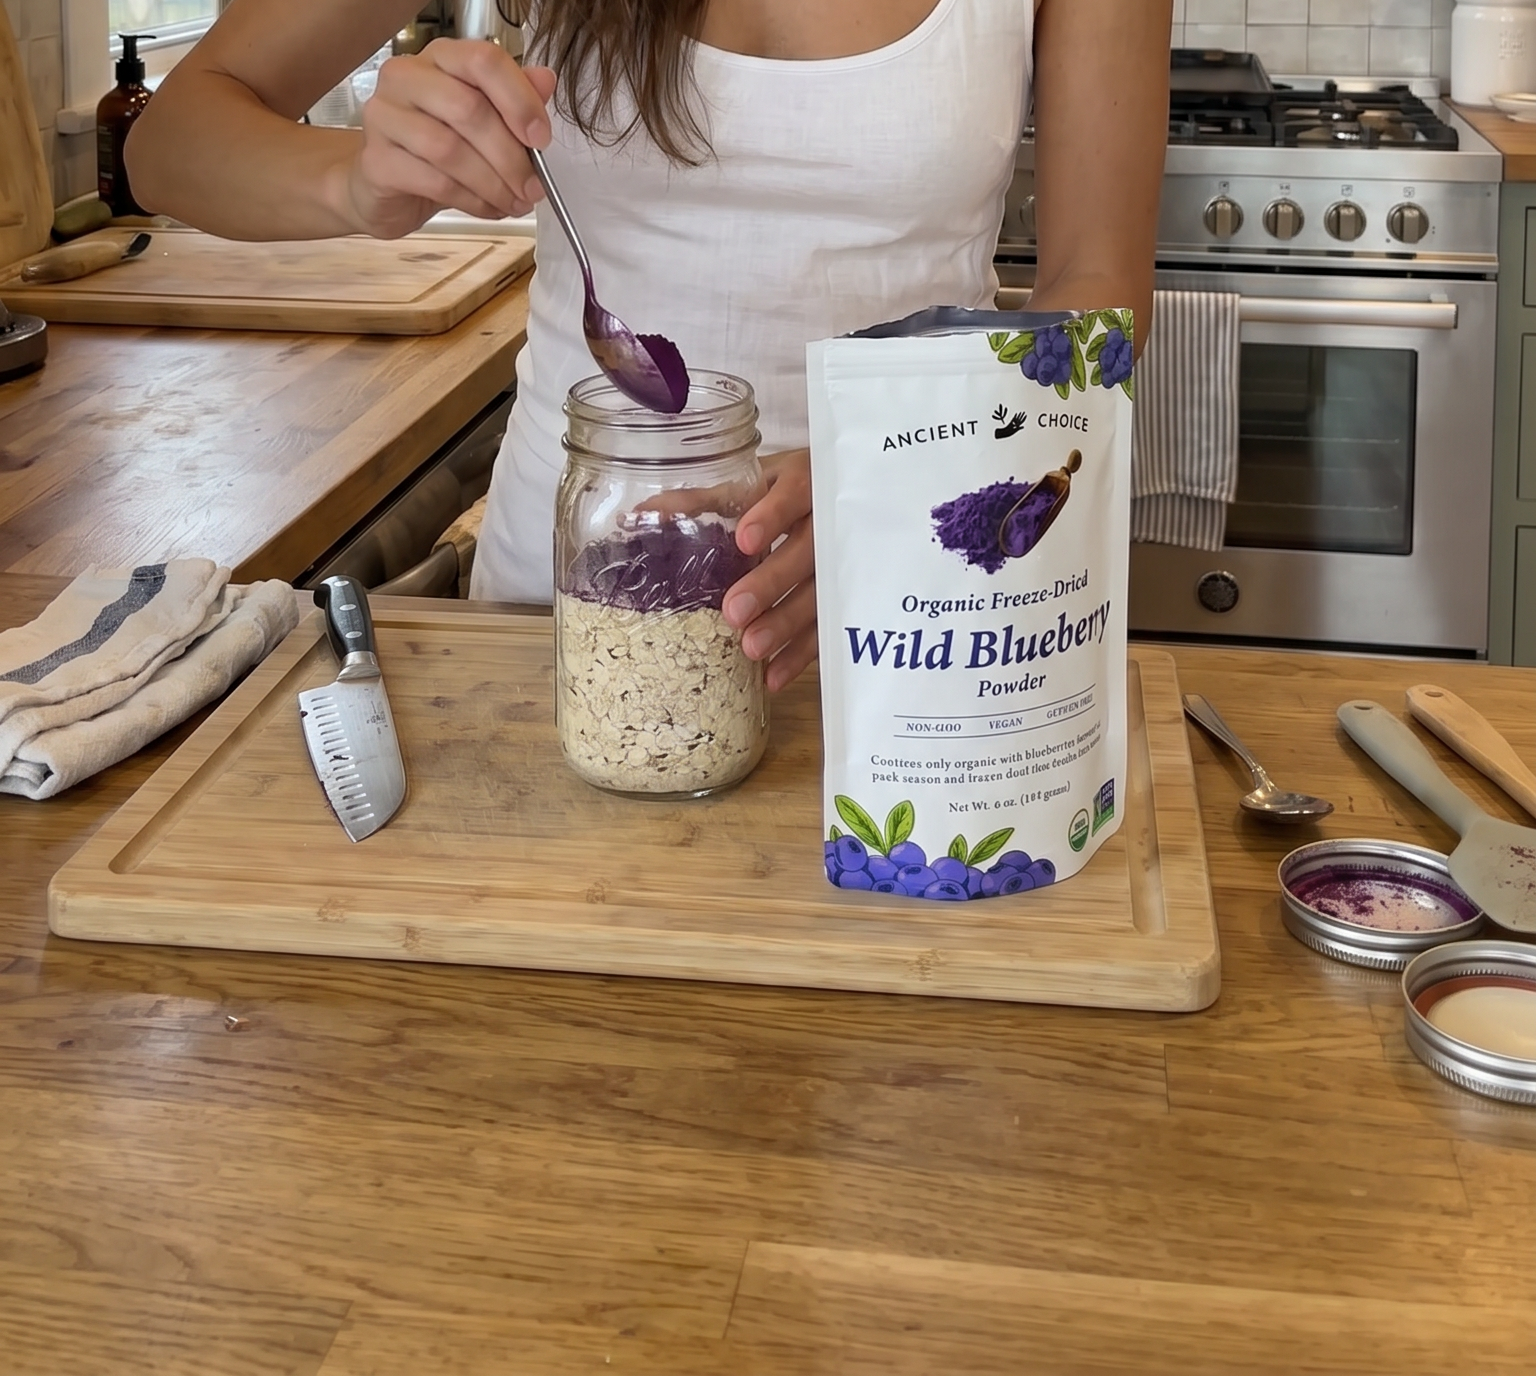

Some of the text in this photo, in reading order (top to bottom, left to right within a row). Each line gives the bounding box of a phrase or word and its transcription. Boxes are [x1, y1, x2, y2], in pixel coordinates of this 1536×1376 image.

[883, 412, 1089, 452] ANCIENT CHOICE
[901, 594, 985, 619] Organic
[844, 599, 1111, 671] Wild Blueberry
[976, 672, 1047, 698] Powder
[988, 716, 1024, 730] VEGAN
[925, 757, 952, 772] only
[953, 755, 998, 772] organic
[999, 750, 1024, 765] with
[902, 774, 942, 785] season
[943, 773, 966, 785] and
[948, 802, 969, 813] Net
[971, 800, 991, 812] Wt.
[1003, 798, 1018, 808] oz.
